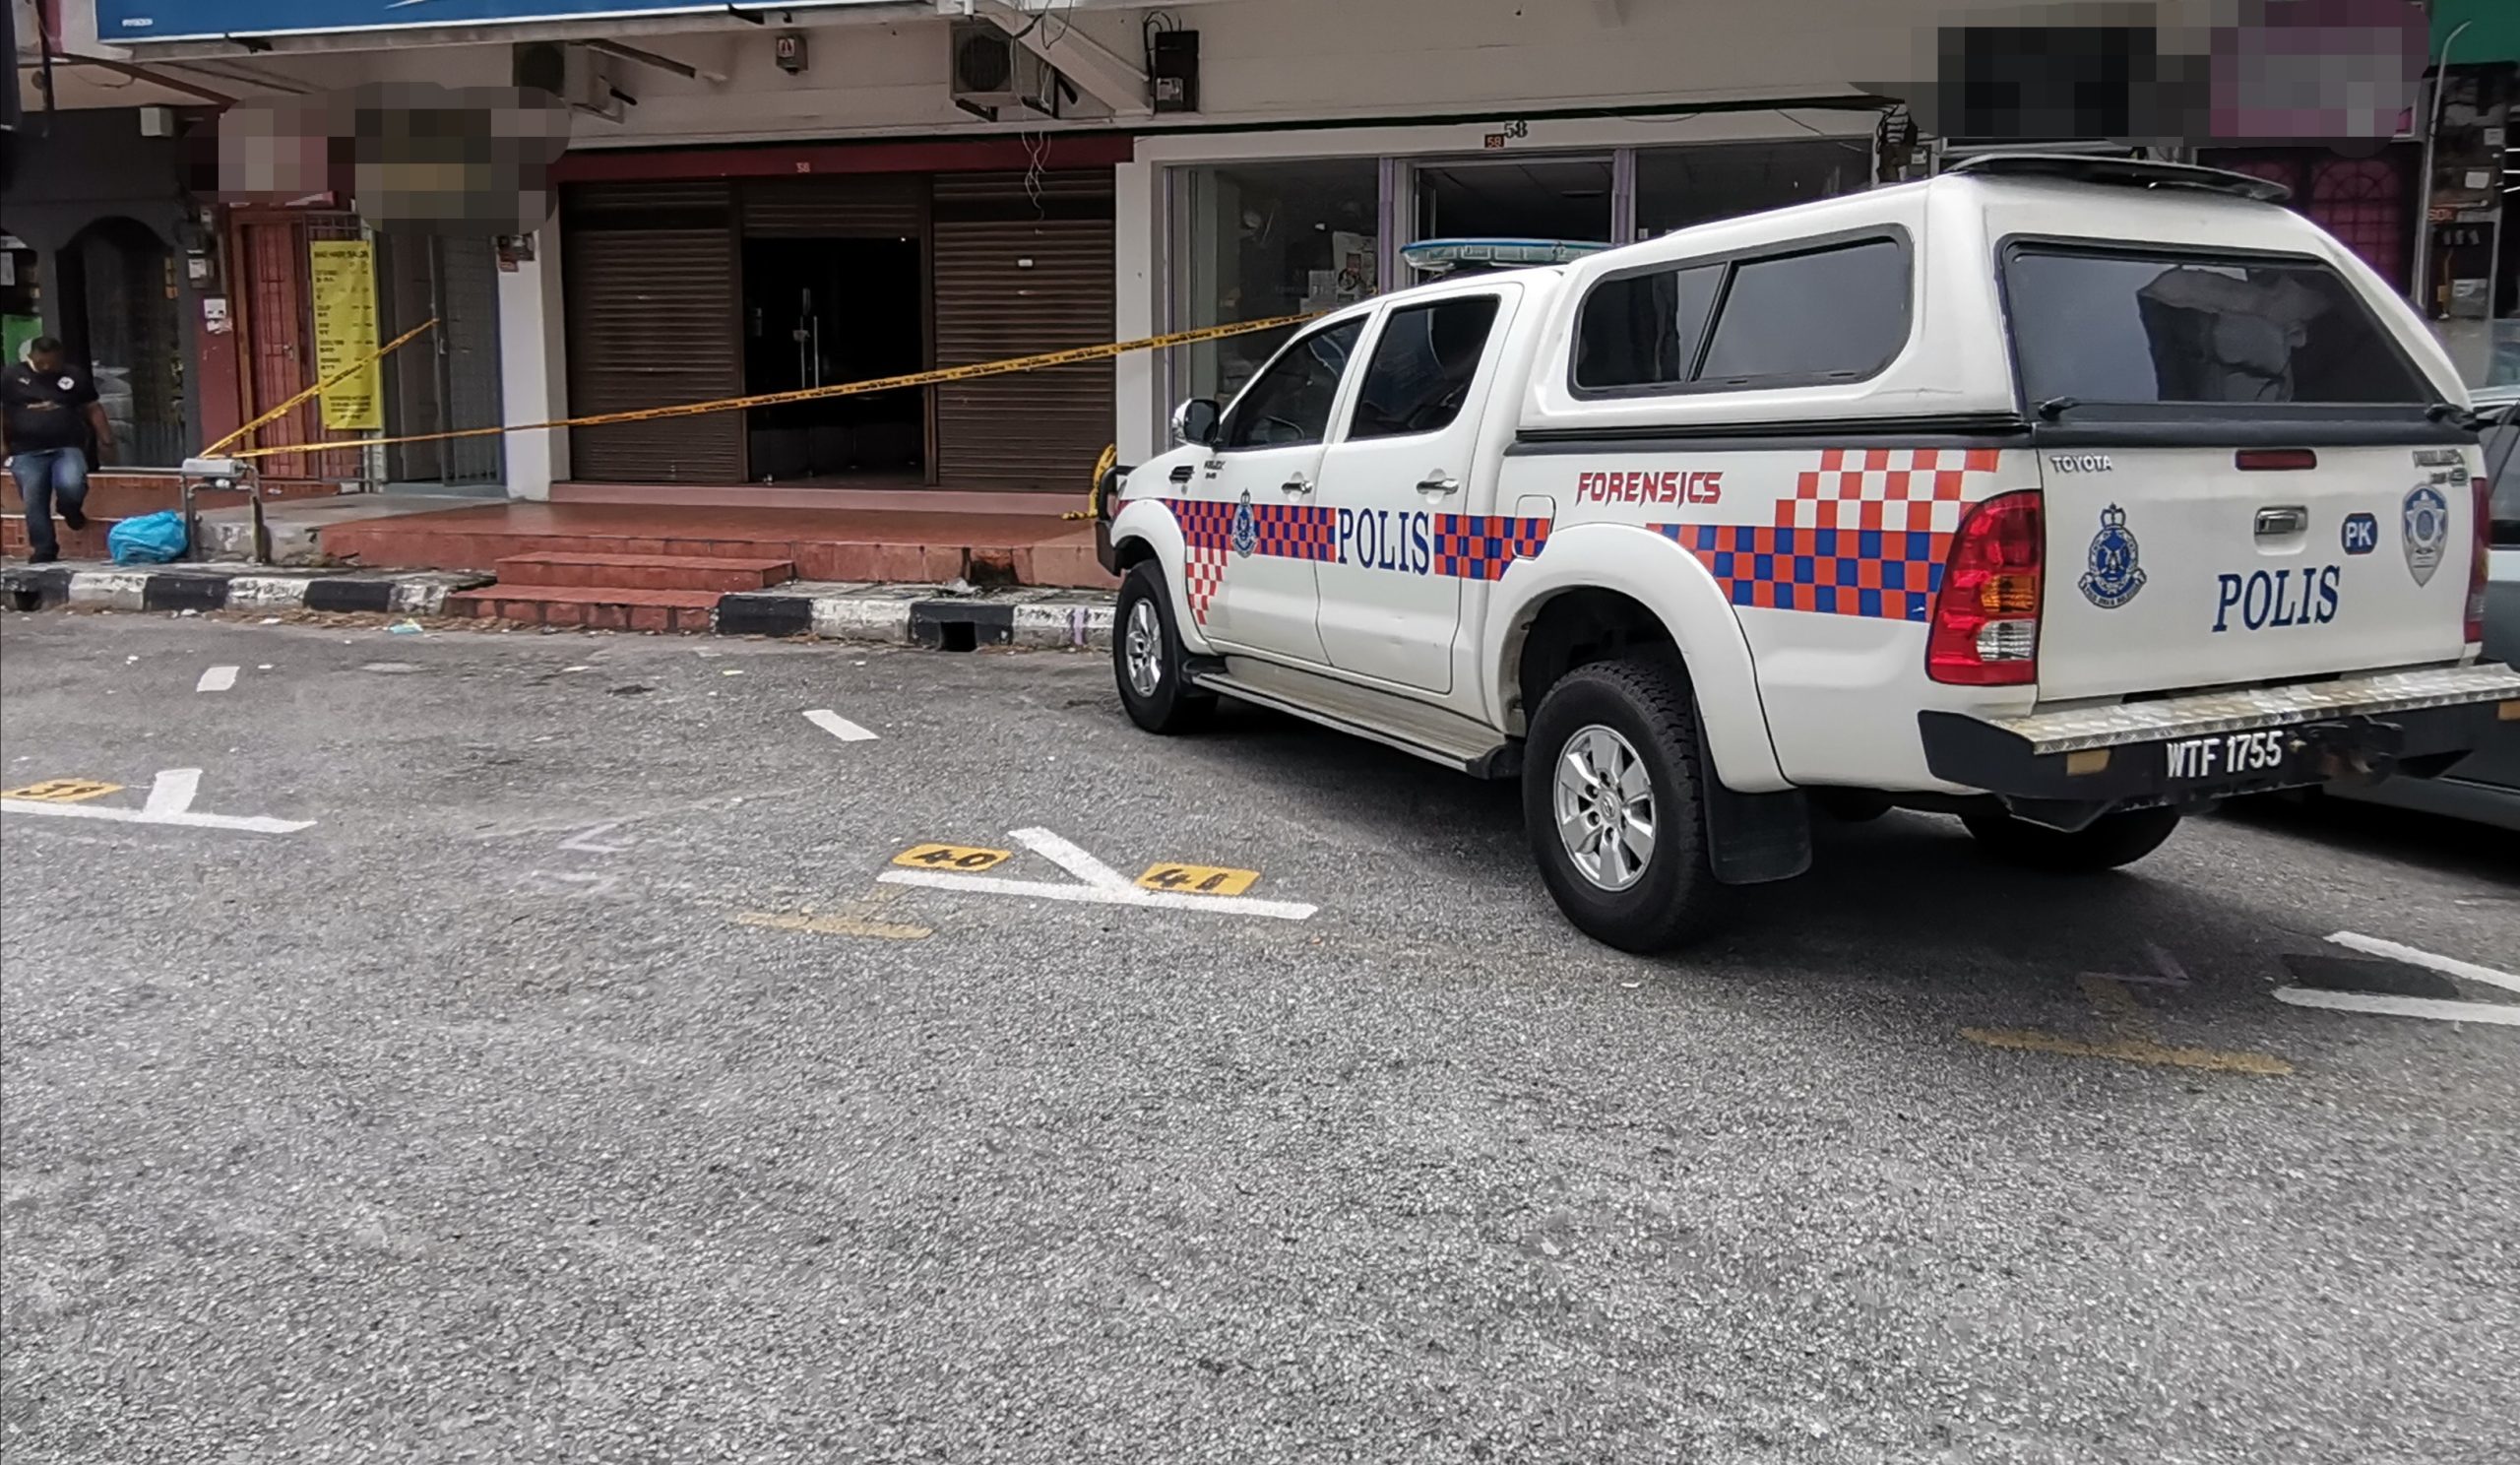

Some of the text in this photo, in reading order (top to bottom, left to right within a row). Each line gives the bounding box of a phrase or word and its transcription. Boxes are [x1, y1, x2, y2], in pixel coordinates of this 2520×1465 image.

[1504, 120, 1529, 139] 58
[2049, 454, 2112, 473] TOYOTA
[1575, 472, 1724, 510] FORENSICS
[1338, 507, 1430, 576] POLIS
[2345, 521, 2372, 547] PK
[2211, 564, 2341, 633] POLIS
[2166, 730, 2284, 779] WTF 1755
[912, 848, 998, 868] 40
[1146, 867, 1229, 892] 41
